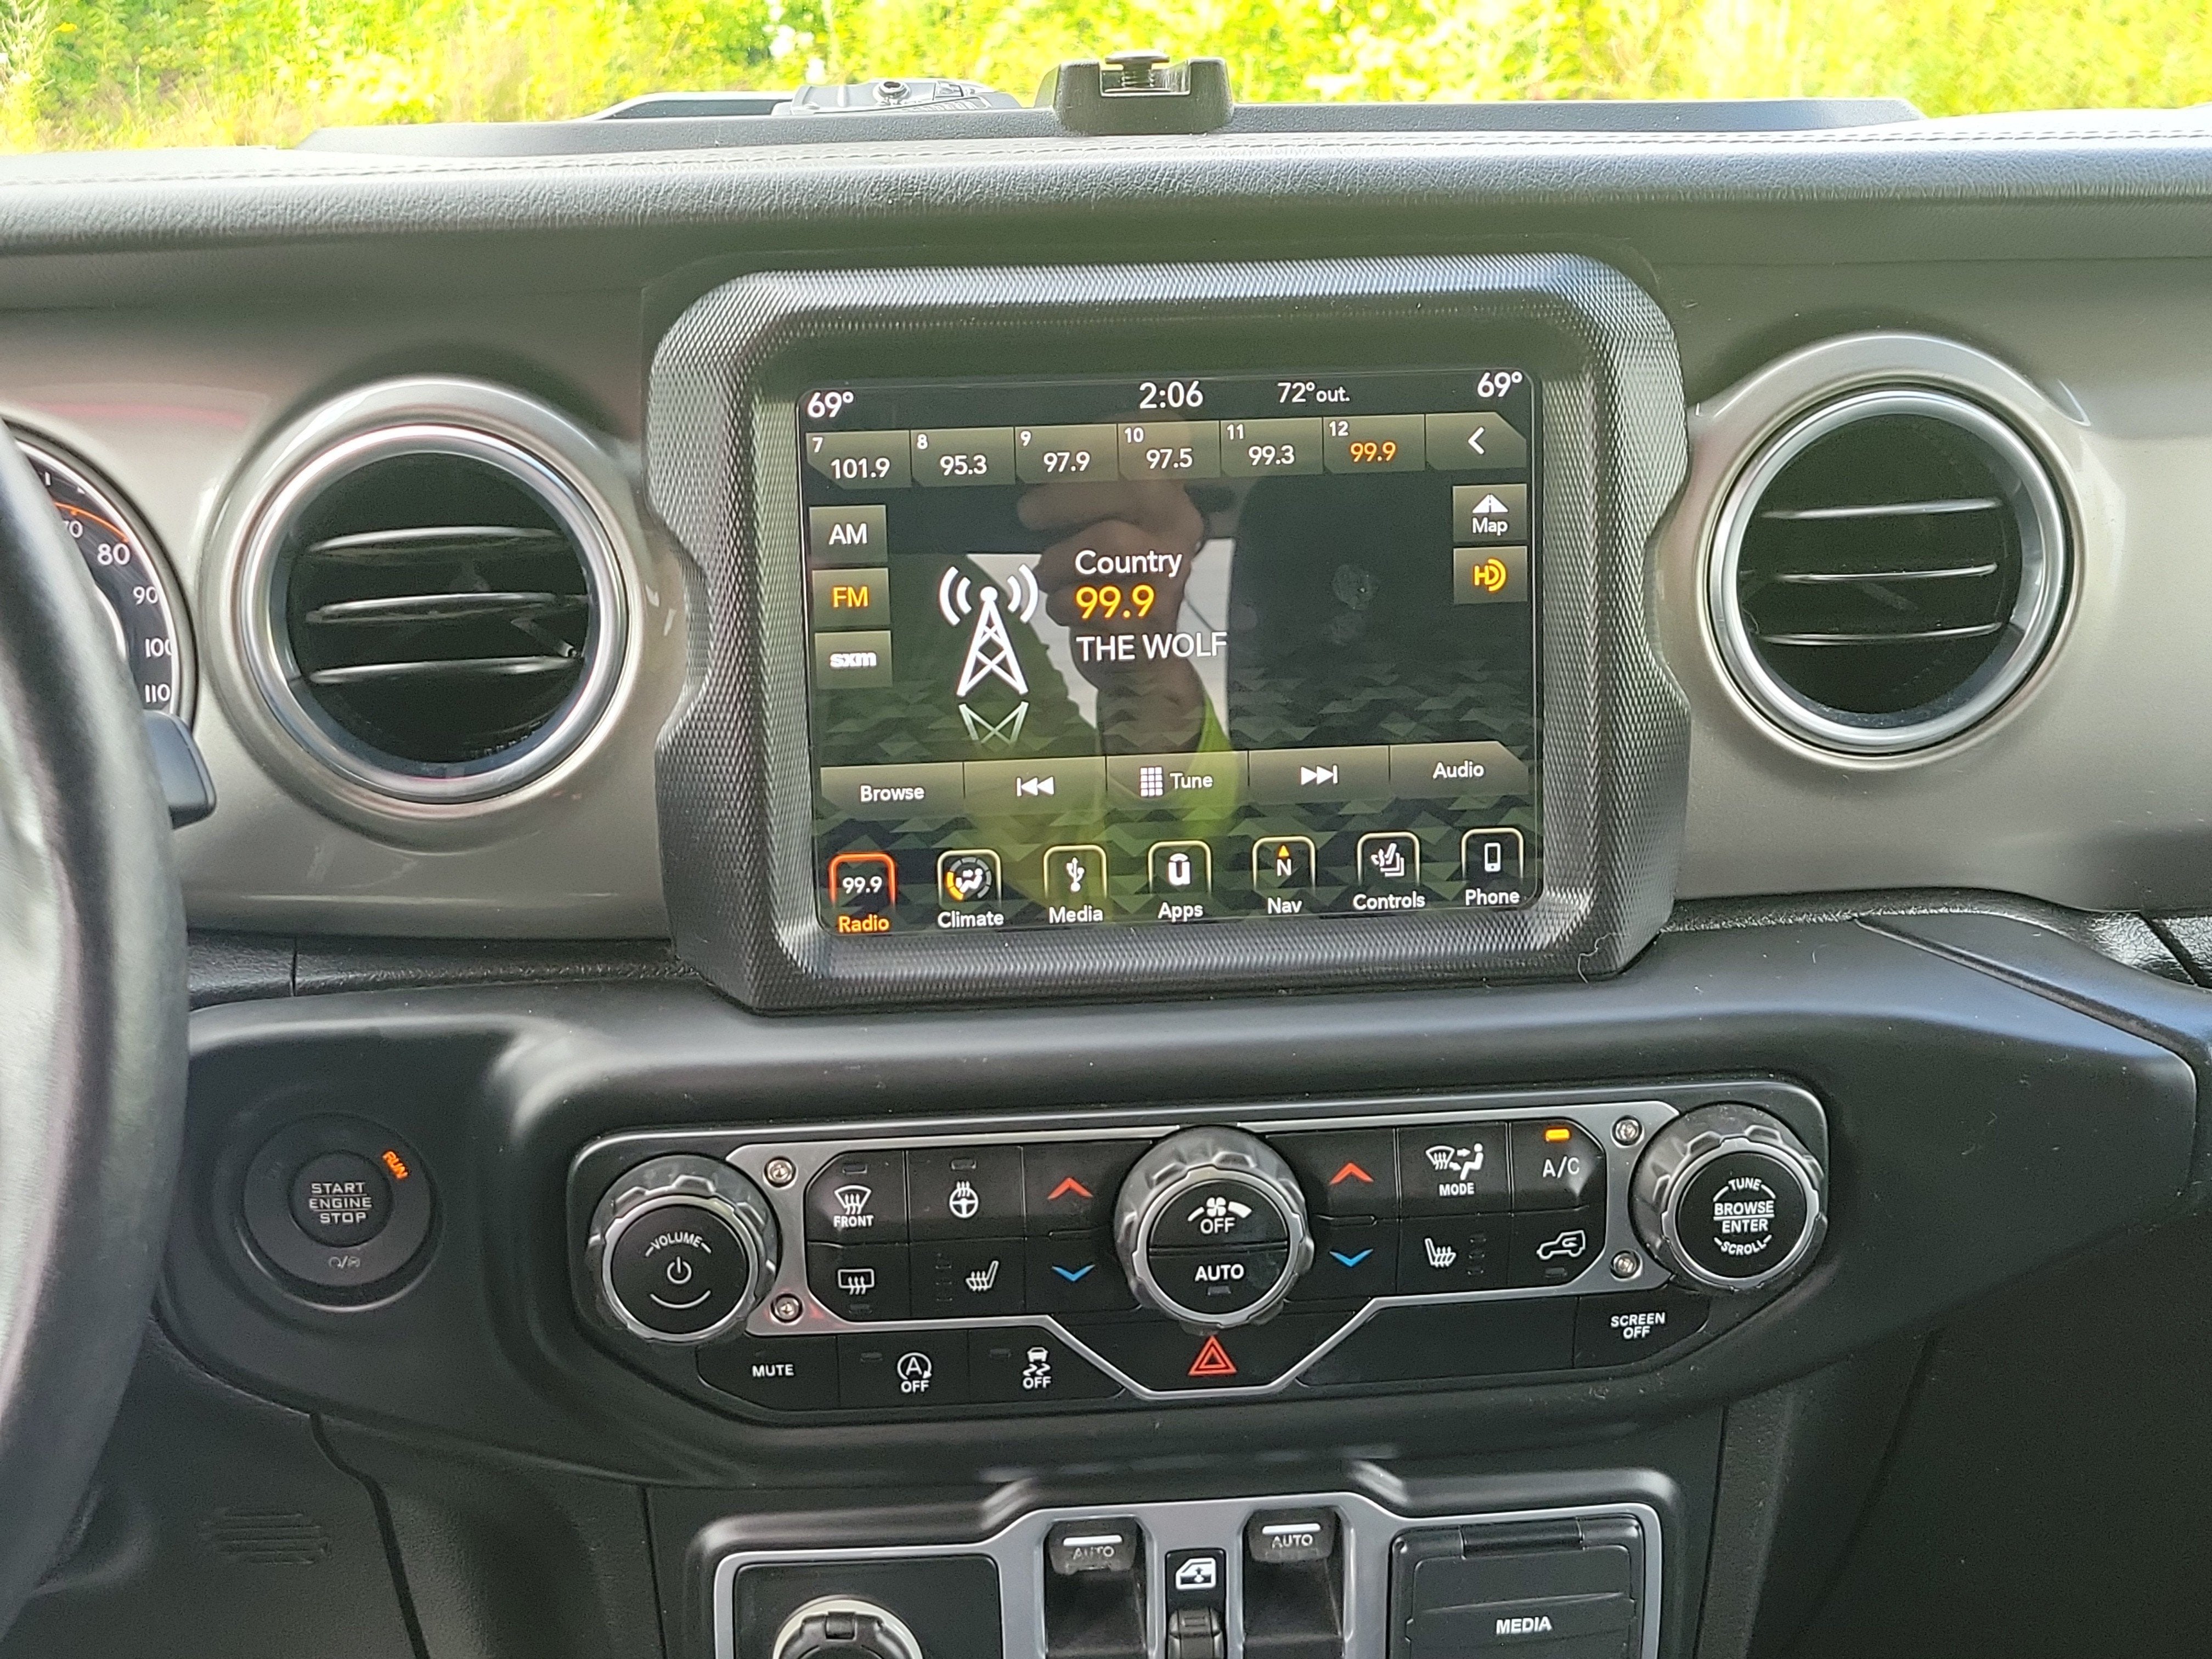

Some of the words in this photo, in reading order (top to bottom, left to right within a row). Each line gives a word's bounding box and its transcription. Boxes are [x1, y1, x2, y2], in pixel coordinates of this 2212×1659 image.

[1477, 371, 1522, 398] 69°
[1139, 381, 1203, 408] 2:06
[808, 392, 854, 417] 69°
[1124, 428, 1144, 442] 10
[1227, 425, 1244, 439] 11
[1329, 422, 1348, 436] 12
[812, 437, 823, 452] 7
[917, 435, 928, 449] 8
[1020, 431, 1031, 445] 9
[1146, 448, 1192, 469] 97.5
[1249, 445, 1295, 465] 99.3
[1351, 442, 1396, 462] 99.9
[831, 458, 890, 478] 101.9
[940, 455, 986, 475] 95.3
[1043, 452, 1090, 472] 97.9
[829, 524, 867, 544] AM
[1472, 518, 1508, 535] Map
[98, 543, 130, 565] 80
[1075, 551, 1182, 577] Country
[133, 586, 158, 604] 90
[833, 586, 868, 607] FM
[1075, 584, 1154, 619] 99.9
[1076, 635, 1134, 661] THE
[1143, 632, 1227, 659] WOLF
[145, 684, 170, 703] 110
[1433, 762, 1484, 779] Audio
[1170, 773, 1212, 789] Tune
[860, 784, 924, 802] Browse
[842, 876, 882, 894] 99.9
[1268, 898, 1302, 914] Nav
[1353, 891, 1425, 911] Controls
[1465, 889, 1519, 906] Phone
[938, 910, 1004, 928] Climate
[1049, 905, 1103, 924] Media
[1158, 902, 1203, 922] Apps
[838, 914, 889, 933] Radio
[382, 1150, 409, 1180] RUN
[1542, 1156, 1580, 1178] A/C
[311, 1182, 365, 1194] START
[1439, 1183, 1475, 1197] MODE
[1729, 1178, 1762, 1192] TUNE
[308, 1197, 373, 1209] ENGINE
[1714, 1200, 1774, 1216] BROWSE
[320, 1212, 367, 1224] STOP
[833, 1215, 873, 1228] FRONT
[1200, 1218, 1235, 1234] OFF
[1722, 1218, 1769, 1234] ENTER
[650, 1232, 703, 1250] VOLUME
[1720, 1240, 1767, 1256] SCROLL
[1195, 1265, 1244, 1281] AUTO
[1611, 1312, 1665, 1327] SCREEN
[1623, 1325, 1650, 1339] OFF
[752, 1364, 794, 1377] MUTE
[900, 1380, 929, 1392] OFF
[1023, 1375, 1051, 1389] OFF
[1271, 1534, 1313, 1549] AUTO
[1073, 1545, 1115, 1559] AUTO
[1496, 1616, 1552, 1635] MEDIA
